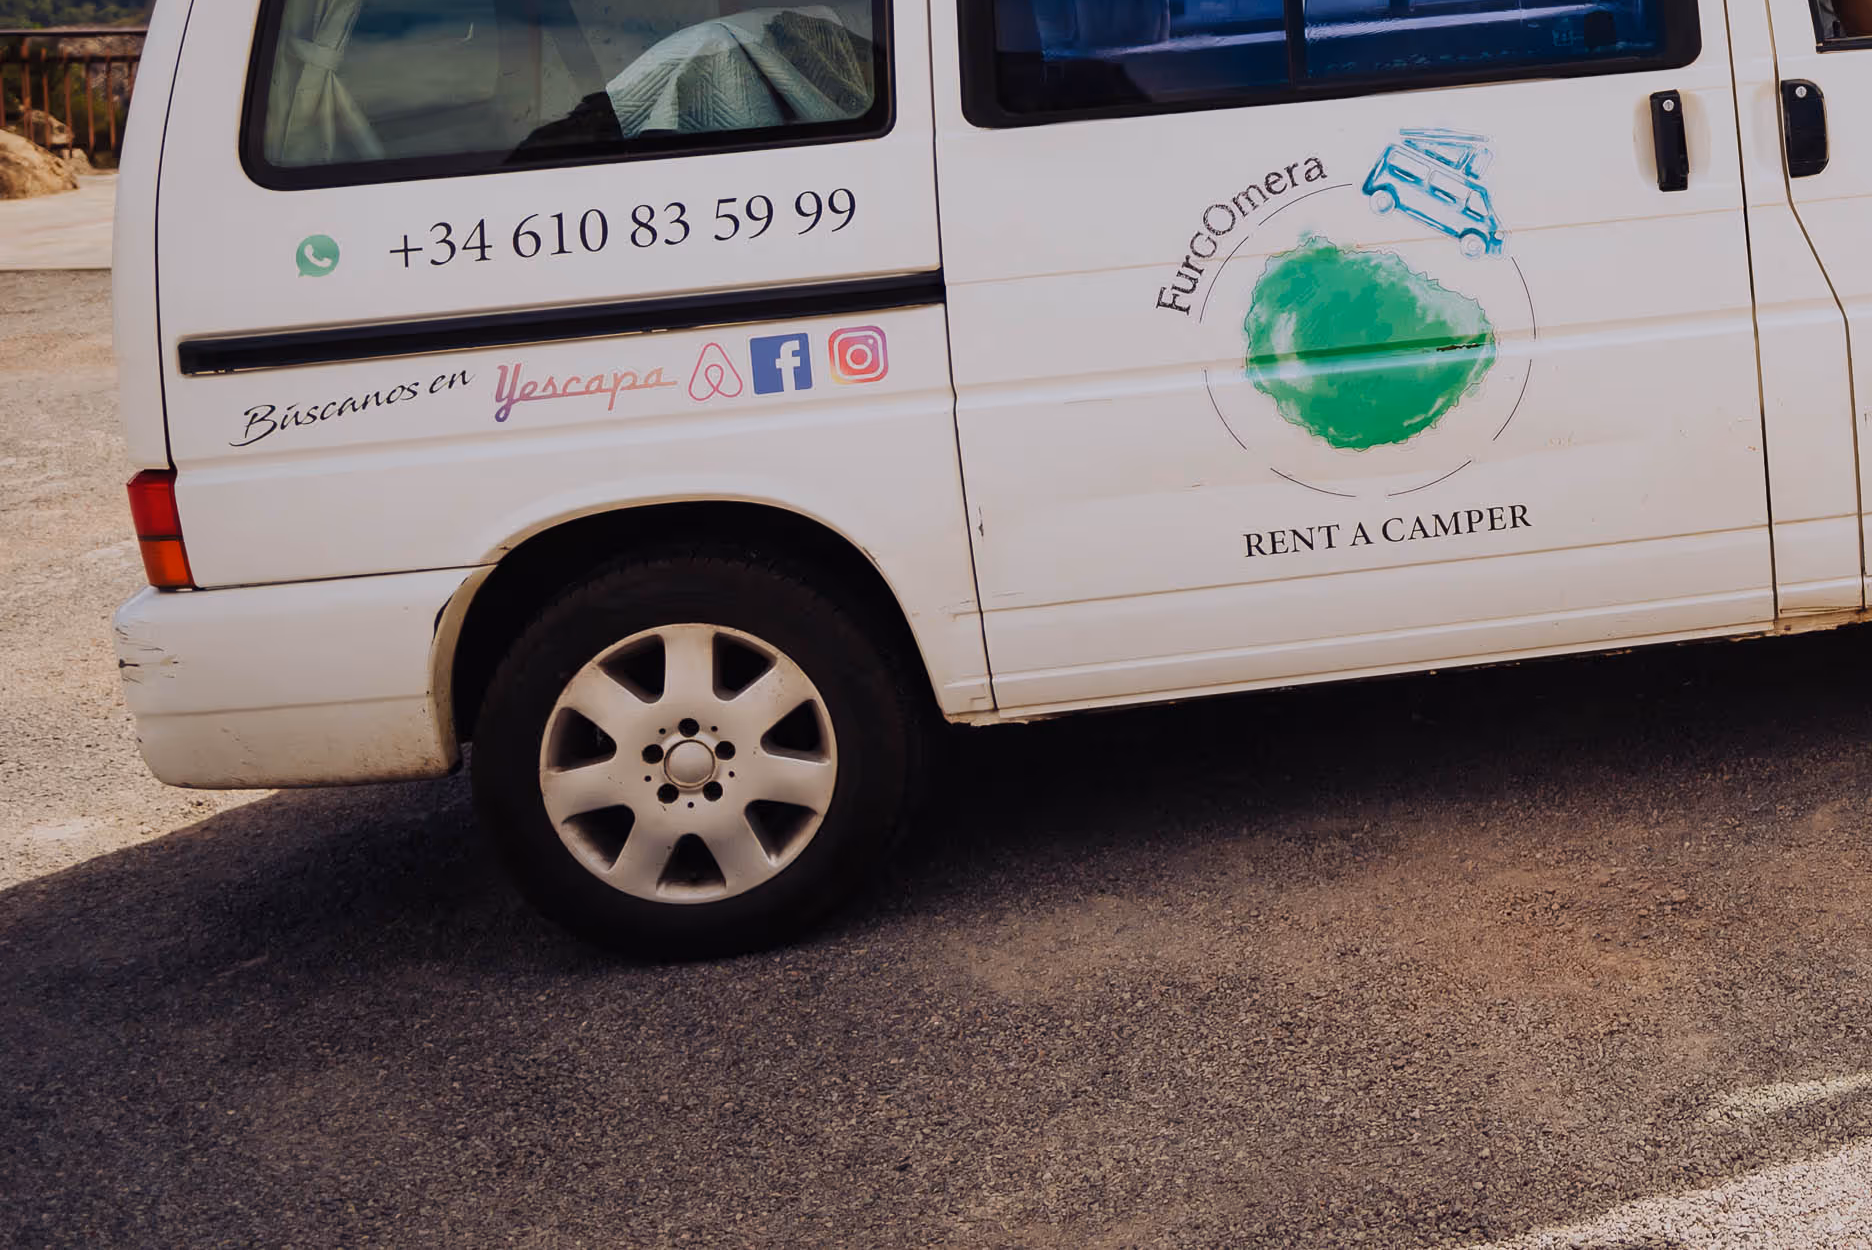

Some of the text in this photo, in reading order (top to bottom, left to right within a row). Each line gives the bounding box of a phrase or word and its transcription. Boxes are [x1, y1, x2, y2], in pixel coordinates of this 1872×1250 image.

[389, 188, 856, 269] +34 610 83 59 99
[229, 362, 678, 448] Búscanos en Yescapa
[1242, 504, 1533, 558] RENT A CAMPER
